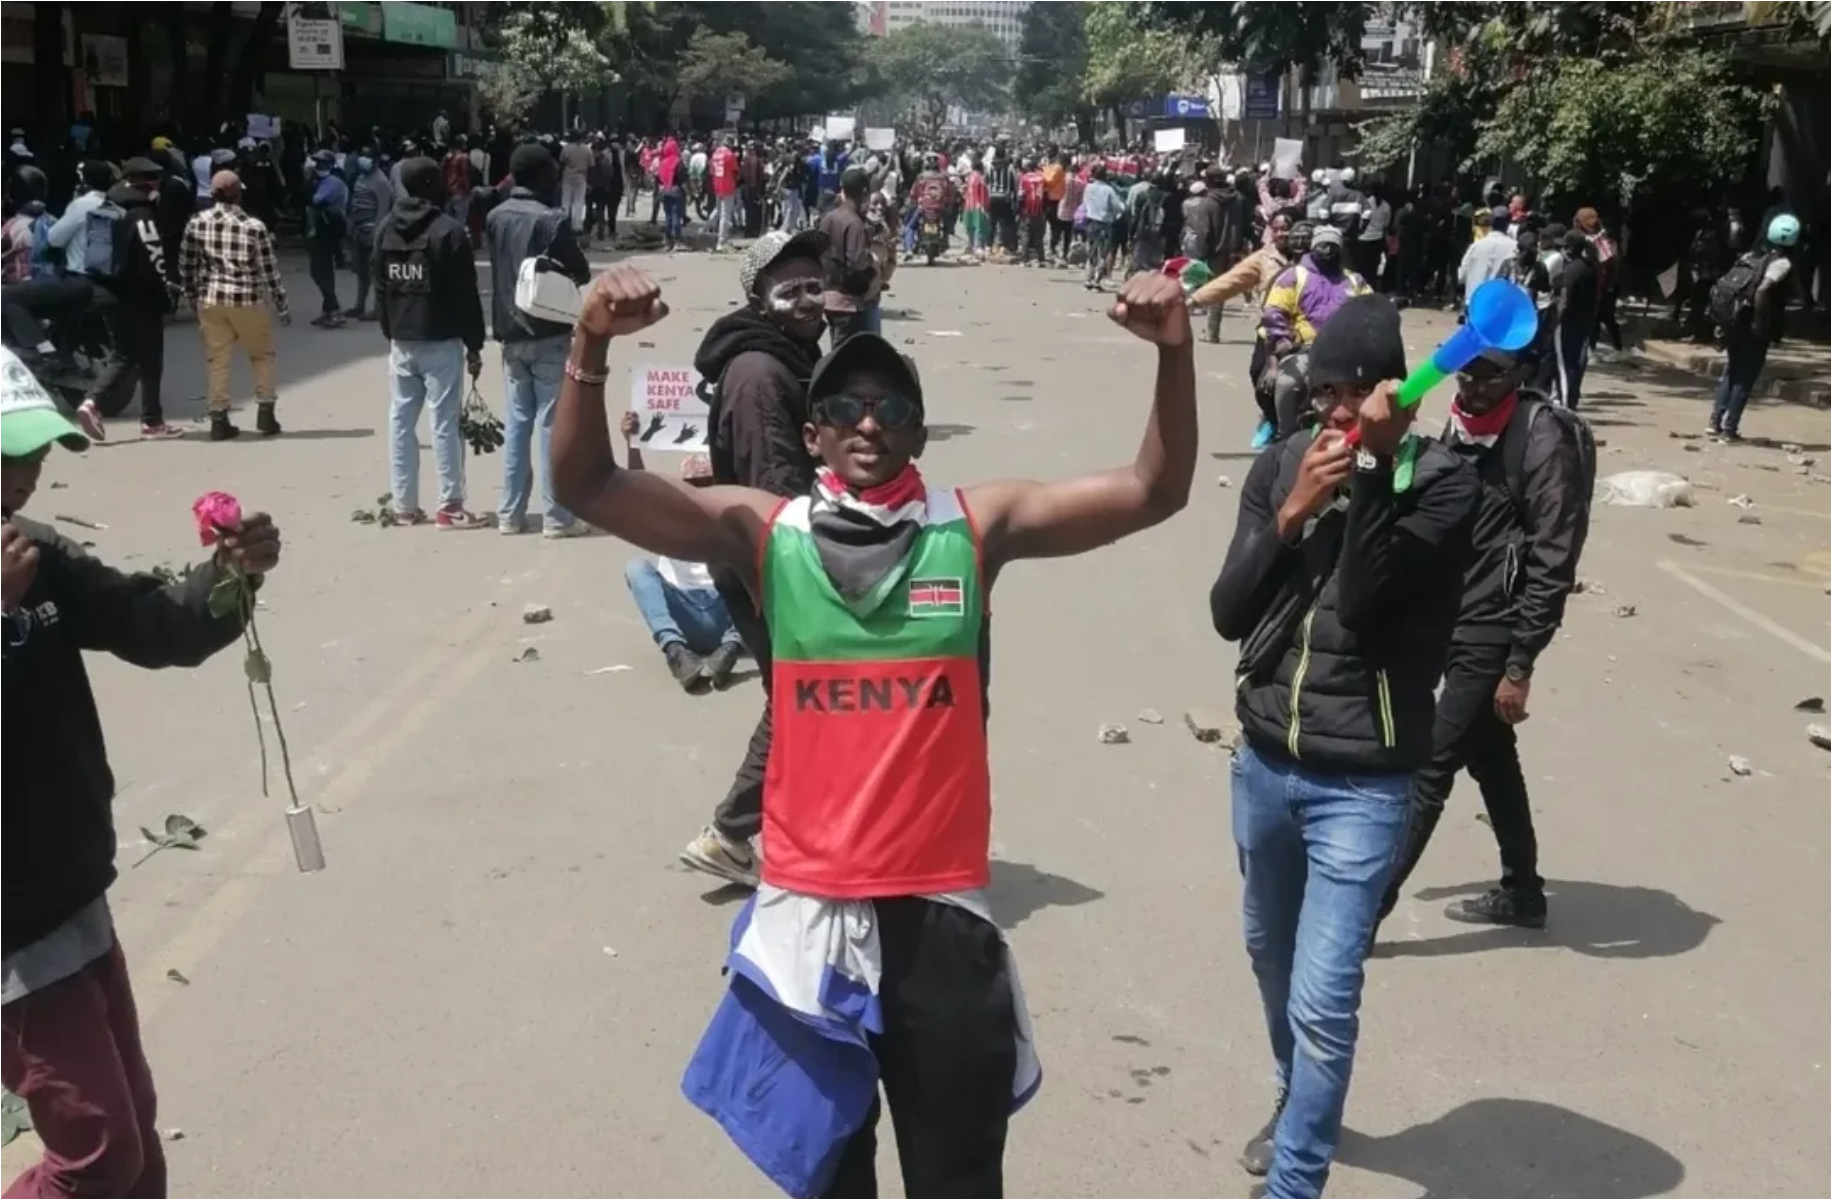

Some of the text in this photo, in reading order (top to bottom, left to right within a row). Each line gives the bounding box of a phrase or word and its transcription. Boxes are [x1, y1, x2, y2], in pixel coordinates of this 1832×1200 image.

[388, 263, 422, 280] RUN
[647, 370, 690, 382] MAKE
[647, 384, 694, 397] KENYA
[647, 398, 680, 411] SAFE
[795, 675, 957, 712] KENYA
